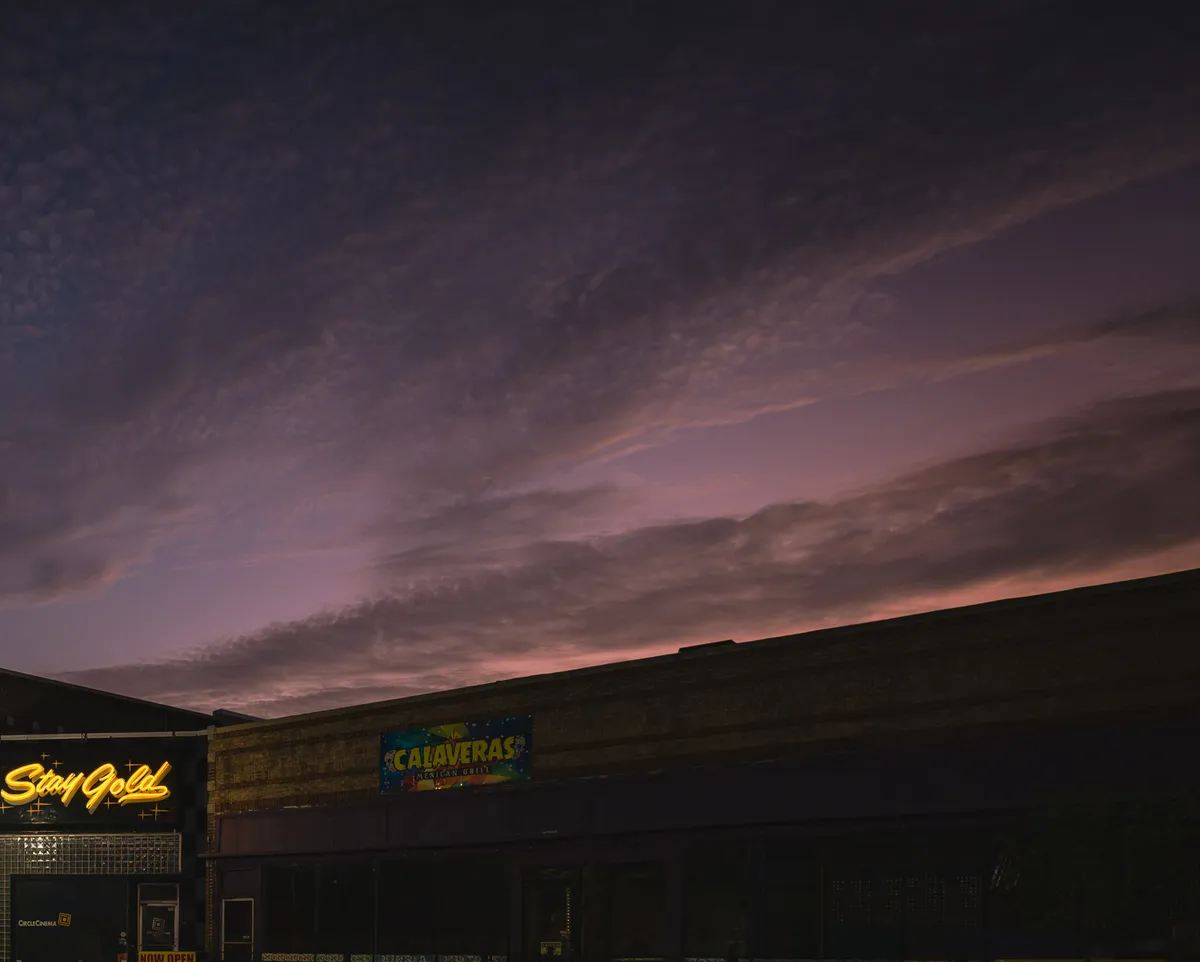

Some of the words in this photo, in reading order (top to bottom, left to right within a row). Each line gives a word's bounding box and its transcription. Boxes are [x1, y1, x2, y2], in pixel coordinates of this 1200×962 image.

[393, 736, 515, 771] CALAVERAS
[1, 763, 85, 807] Stay
[82, 761, 172, 814] Gold
[416, 769, 458, 780] MEXICAN
